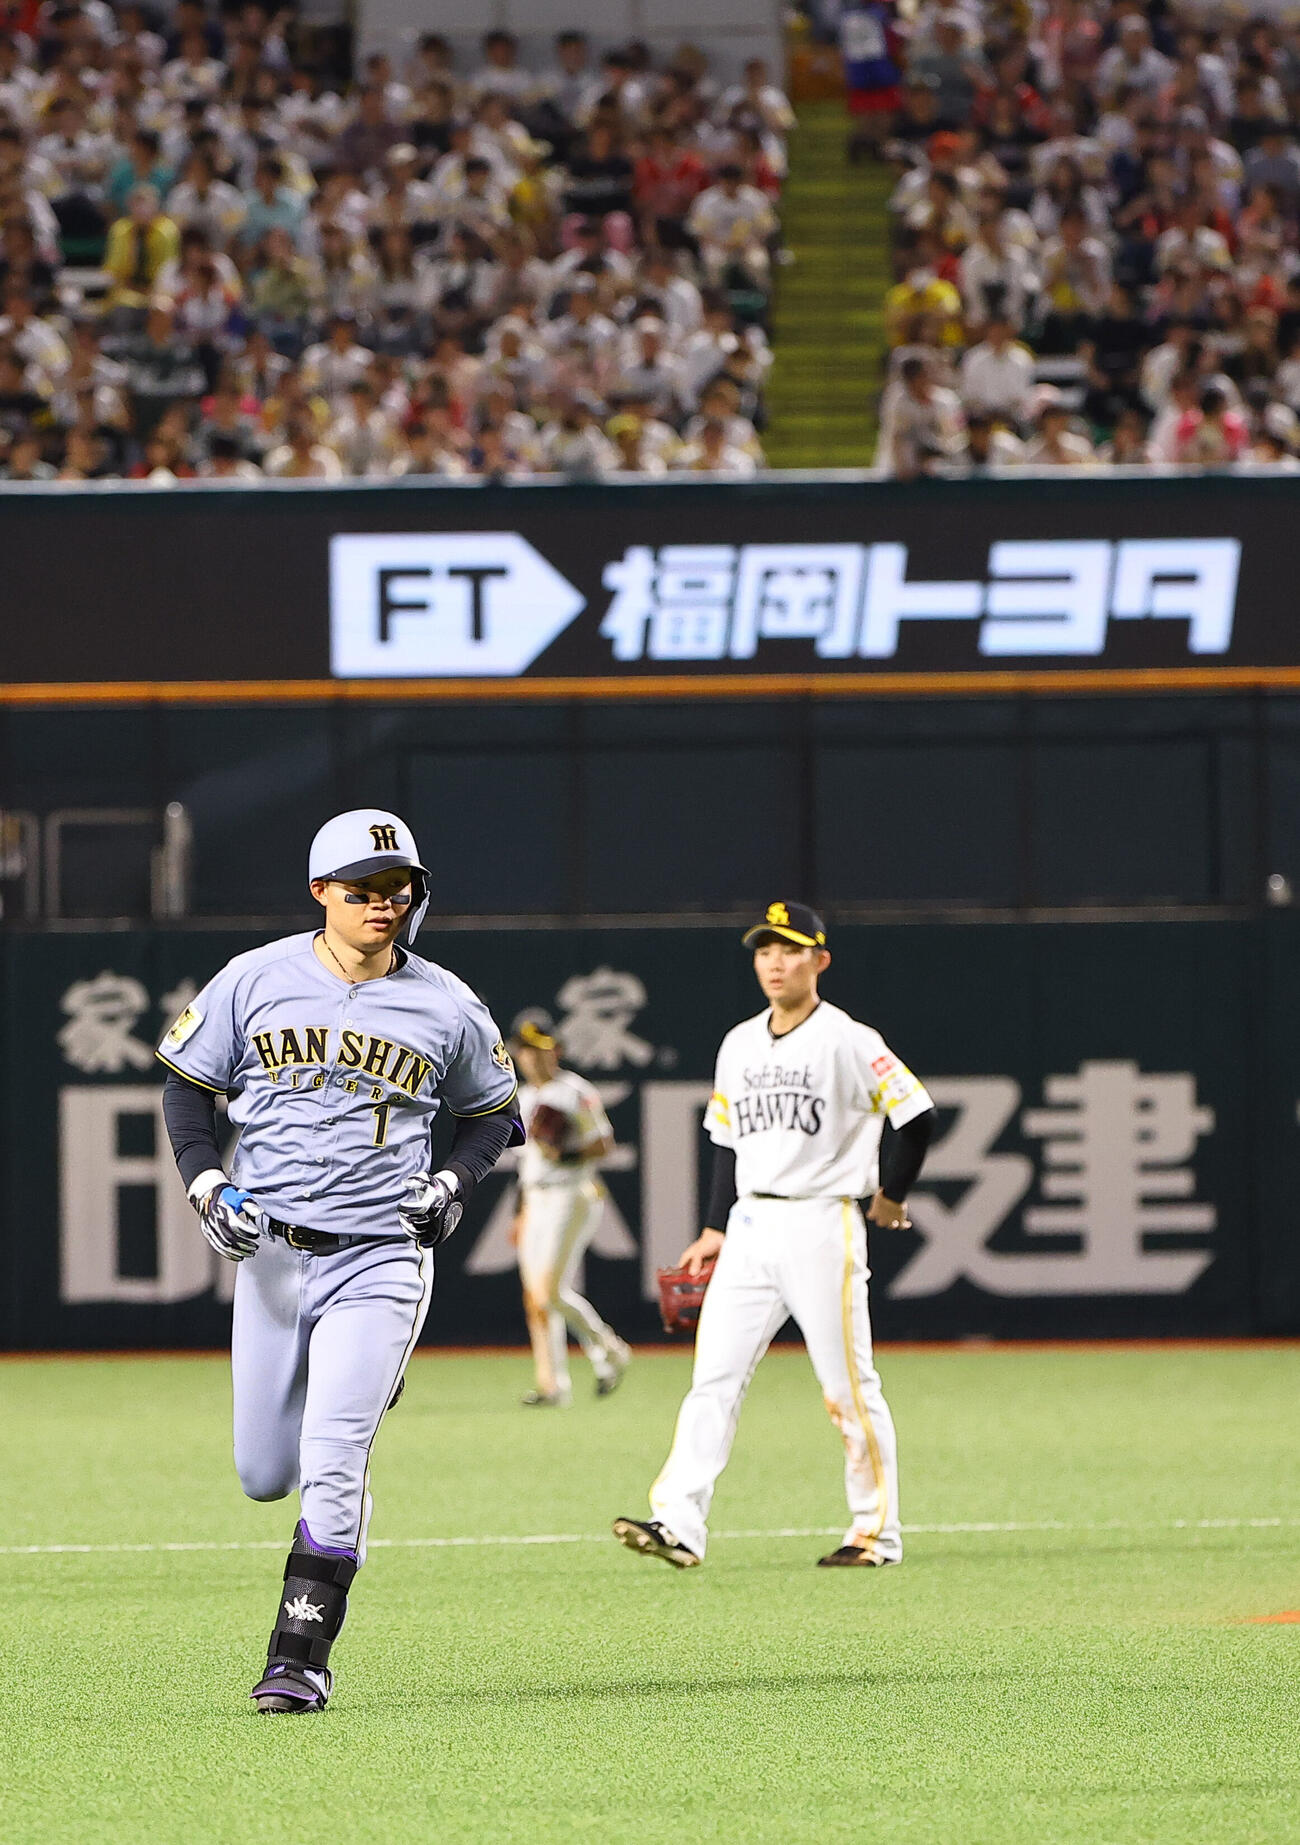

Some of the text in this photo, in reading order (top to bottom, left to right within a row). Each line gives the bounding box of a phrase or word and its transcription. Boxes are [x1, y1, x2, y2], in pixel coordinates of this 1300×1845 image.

[377, 567, 508, 643] FT
[600, 537, 1241, 661] 福岡トヨタ
[743, 1063, 813, 1093] SoftBank
[373, 1103, 391, 1148] 1
[734, 1092, 826, 1136] HAWKS
